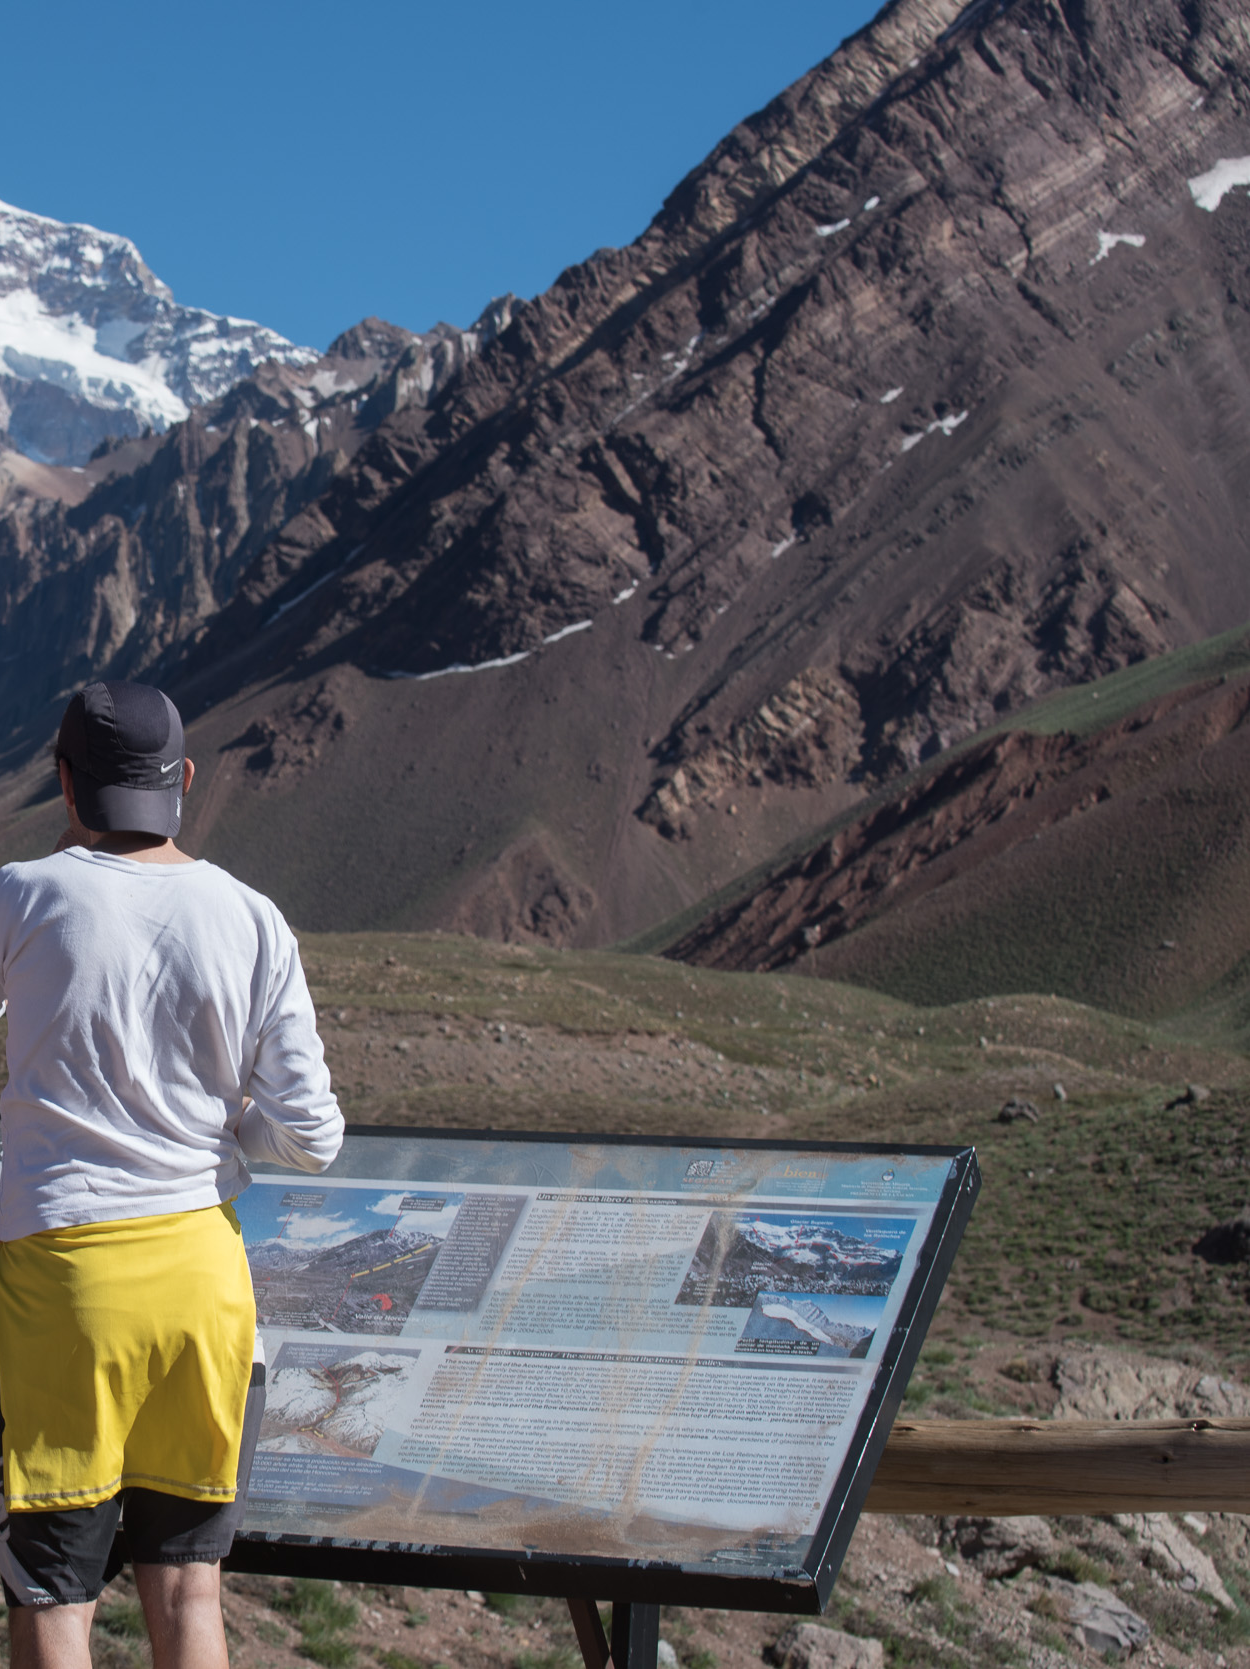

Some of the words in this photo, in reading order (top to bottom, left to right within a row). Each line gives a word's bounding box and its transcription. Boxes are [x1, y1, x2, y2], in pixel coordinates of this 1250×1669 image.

[601, 1195, 622, 1203] libro
[466, 1347, 512, 1356] Aconagua
[512, 1349, 554, 1358] viewpoint
